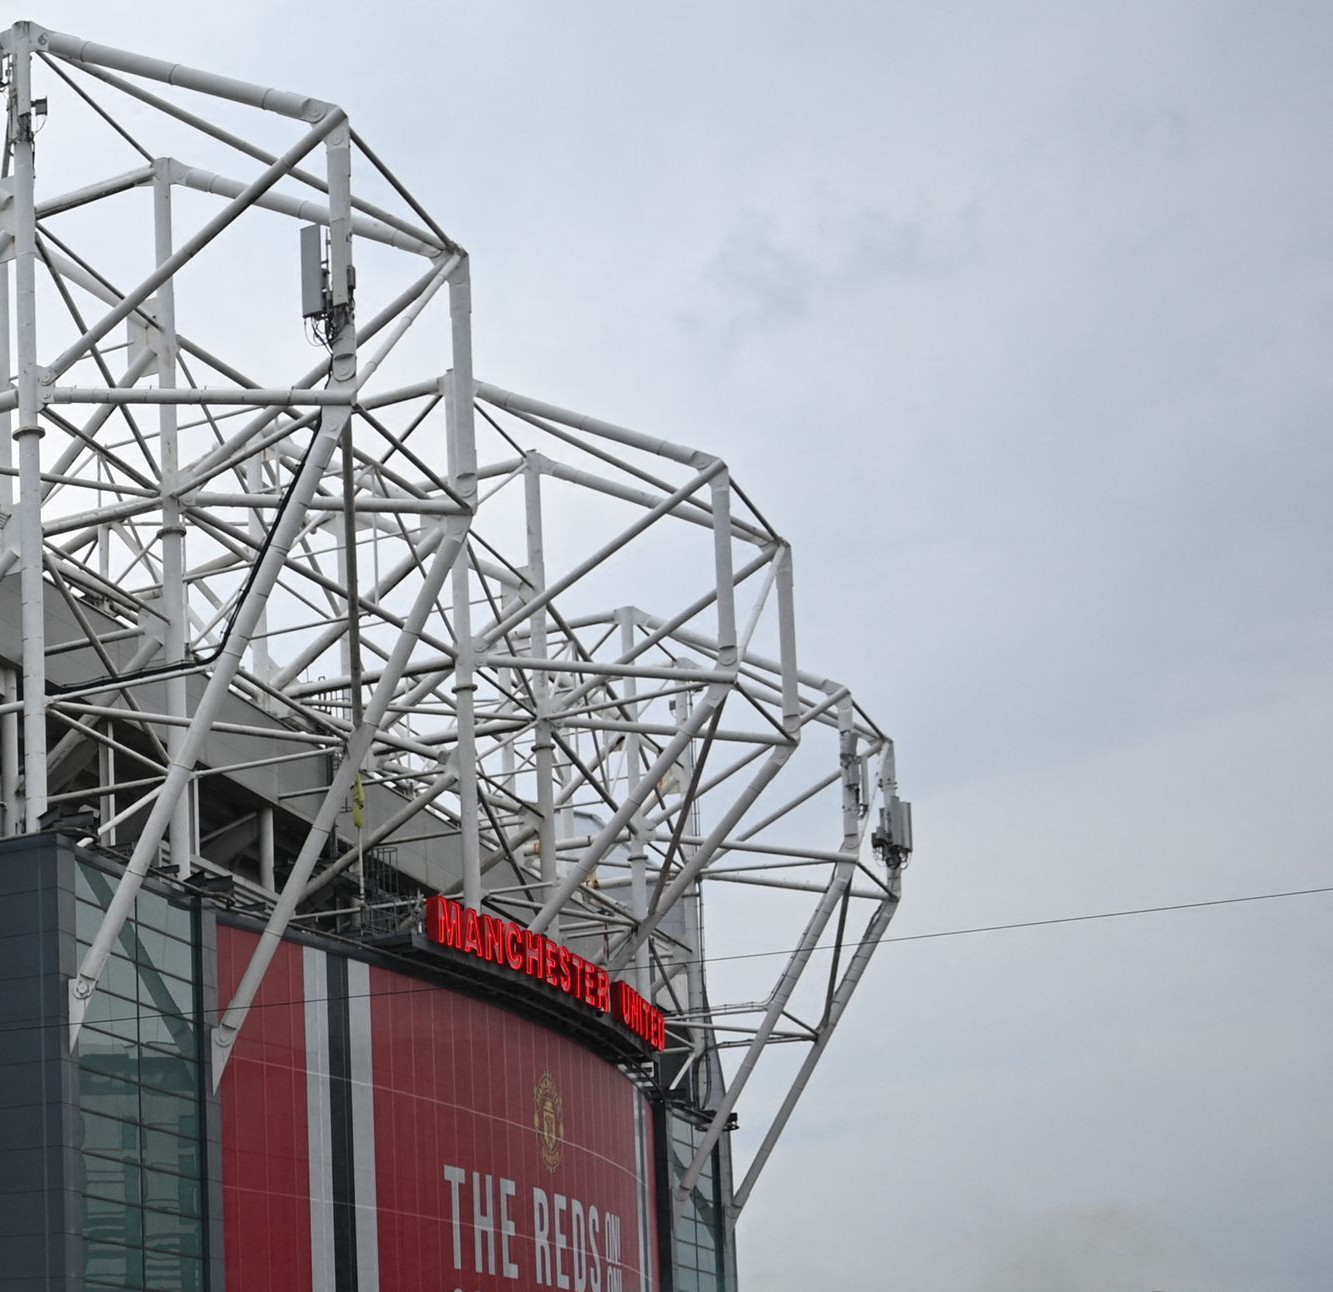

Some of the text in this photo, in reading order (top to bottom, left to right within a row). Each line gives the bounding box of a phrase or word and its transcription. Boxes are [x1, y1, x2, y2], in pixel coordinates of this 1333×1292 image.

[437, 896, 666, 1052] MANCHESTER UNITED
[444, 1165, 519, 1280] THE
[604, 1211, 621, 1266] ON!
